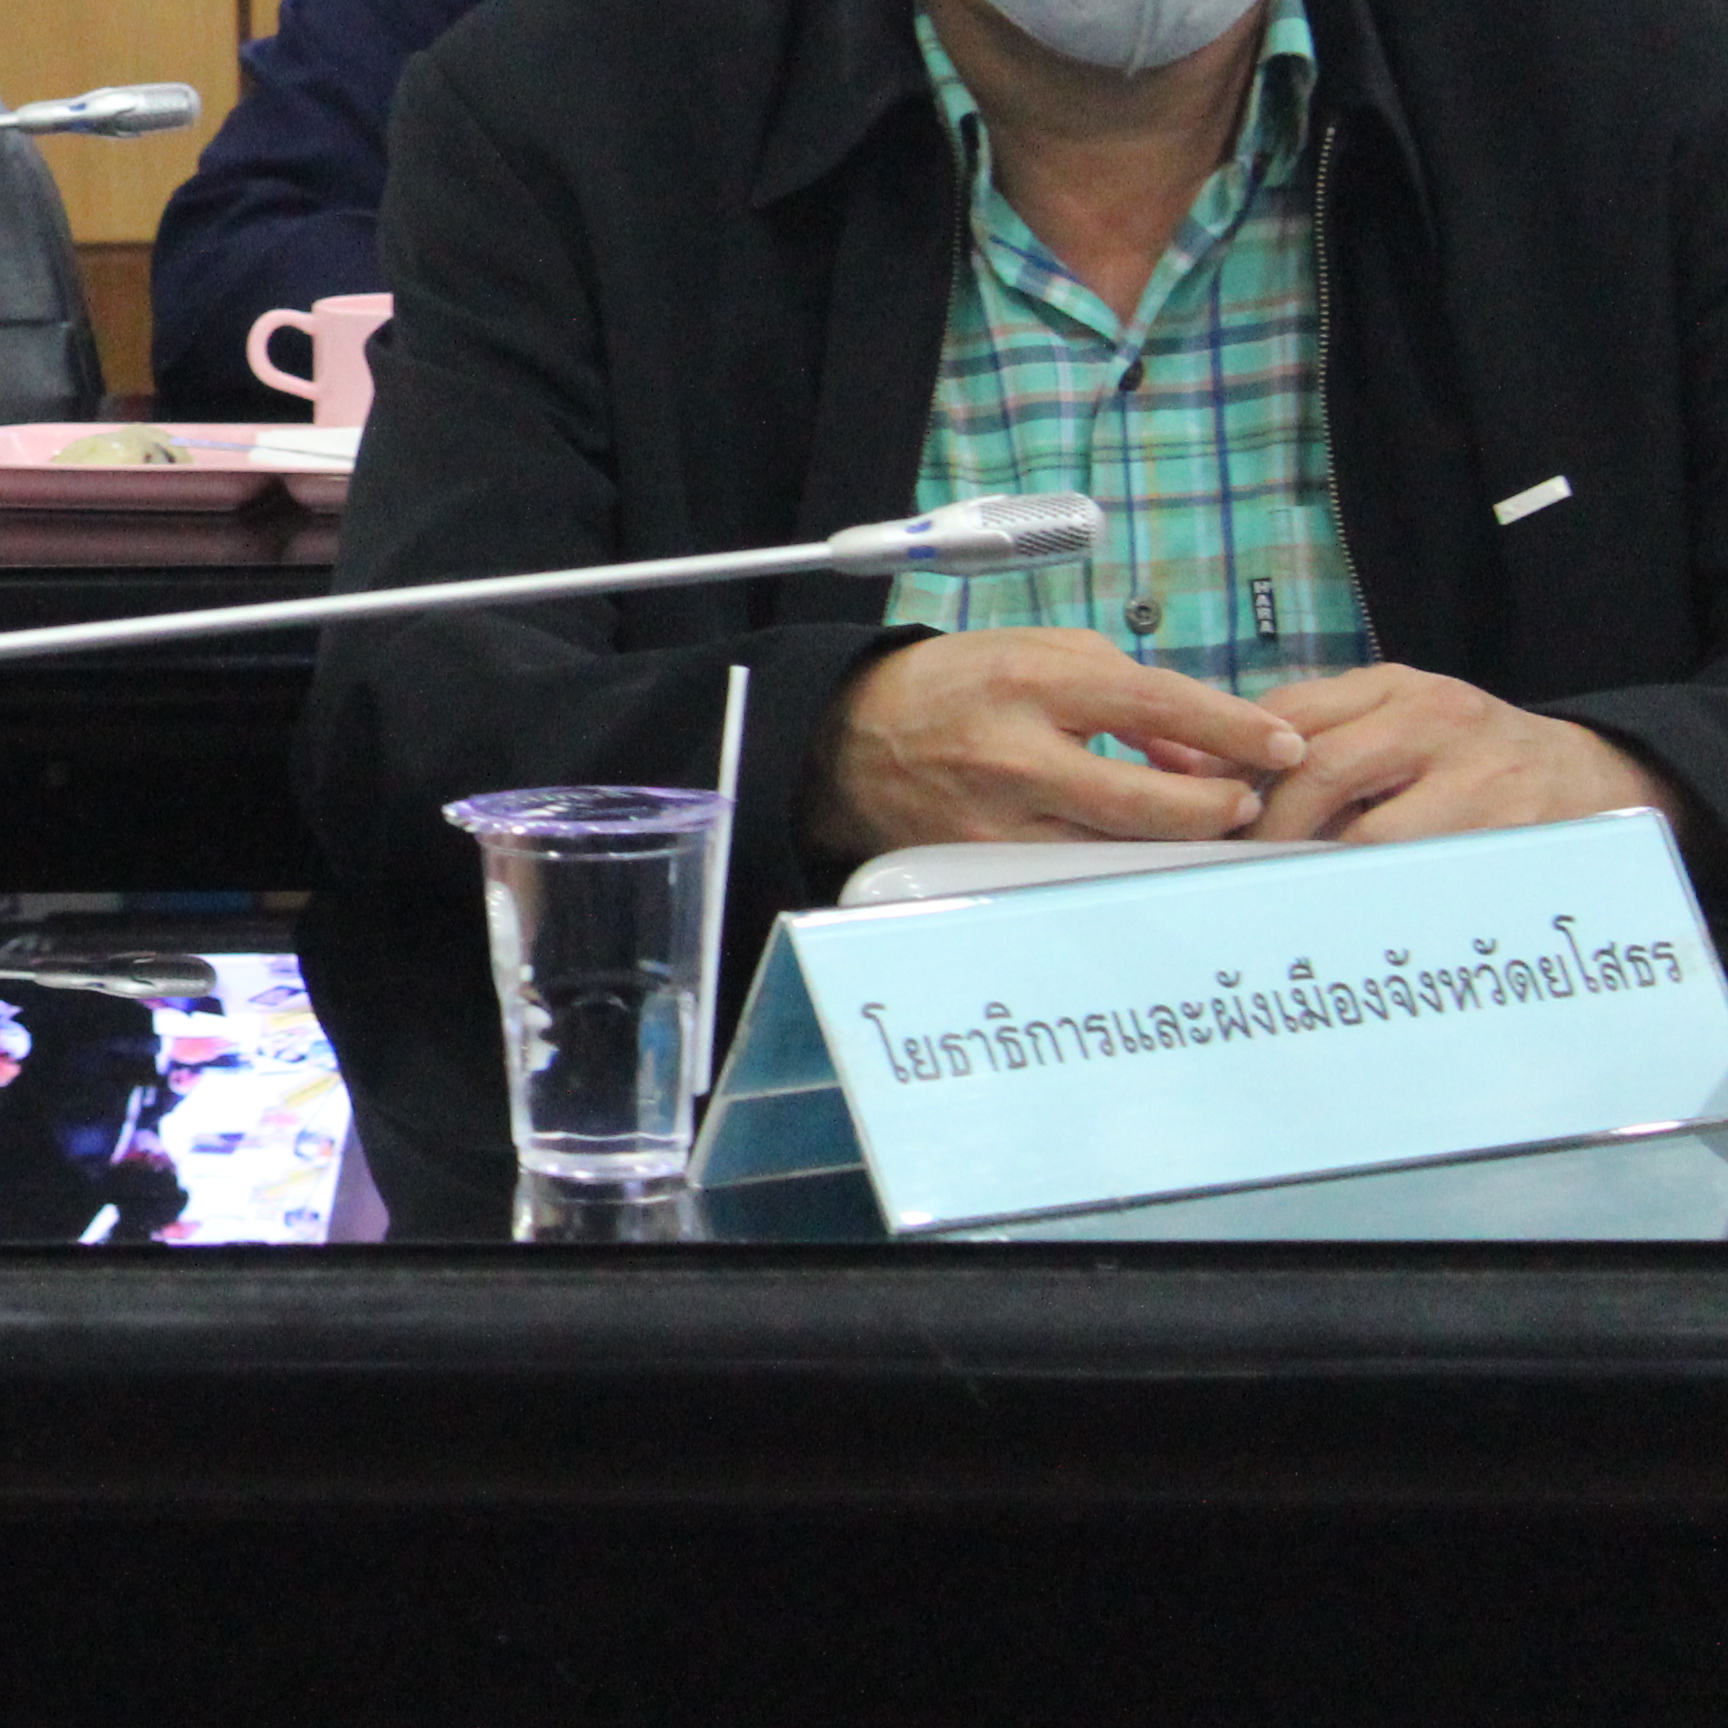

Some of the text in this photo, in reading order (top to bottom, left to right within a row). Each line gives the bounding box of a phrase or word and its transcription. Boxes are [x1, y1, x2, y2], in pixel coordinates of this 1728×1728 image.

[861, 915, 1683, 1085] โยธาธิการและผังเมืองจังหวัดยโสธร
